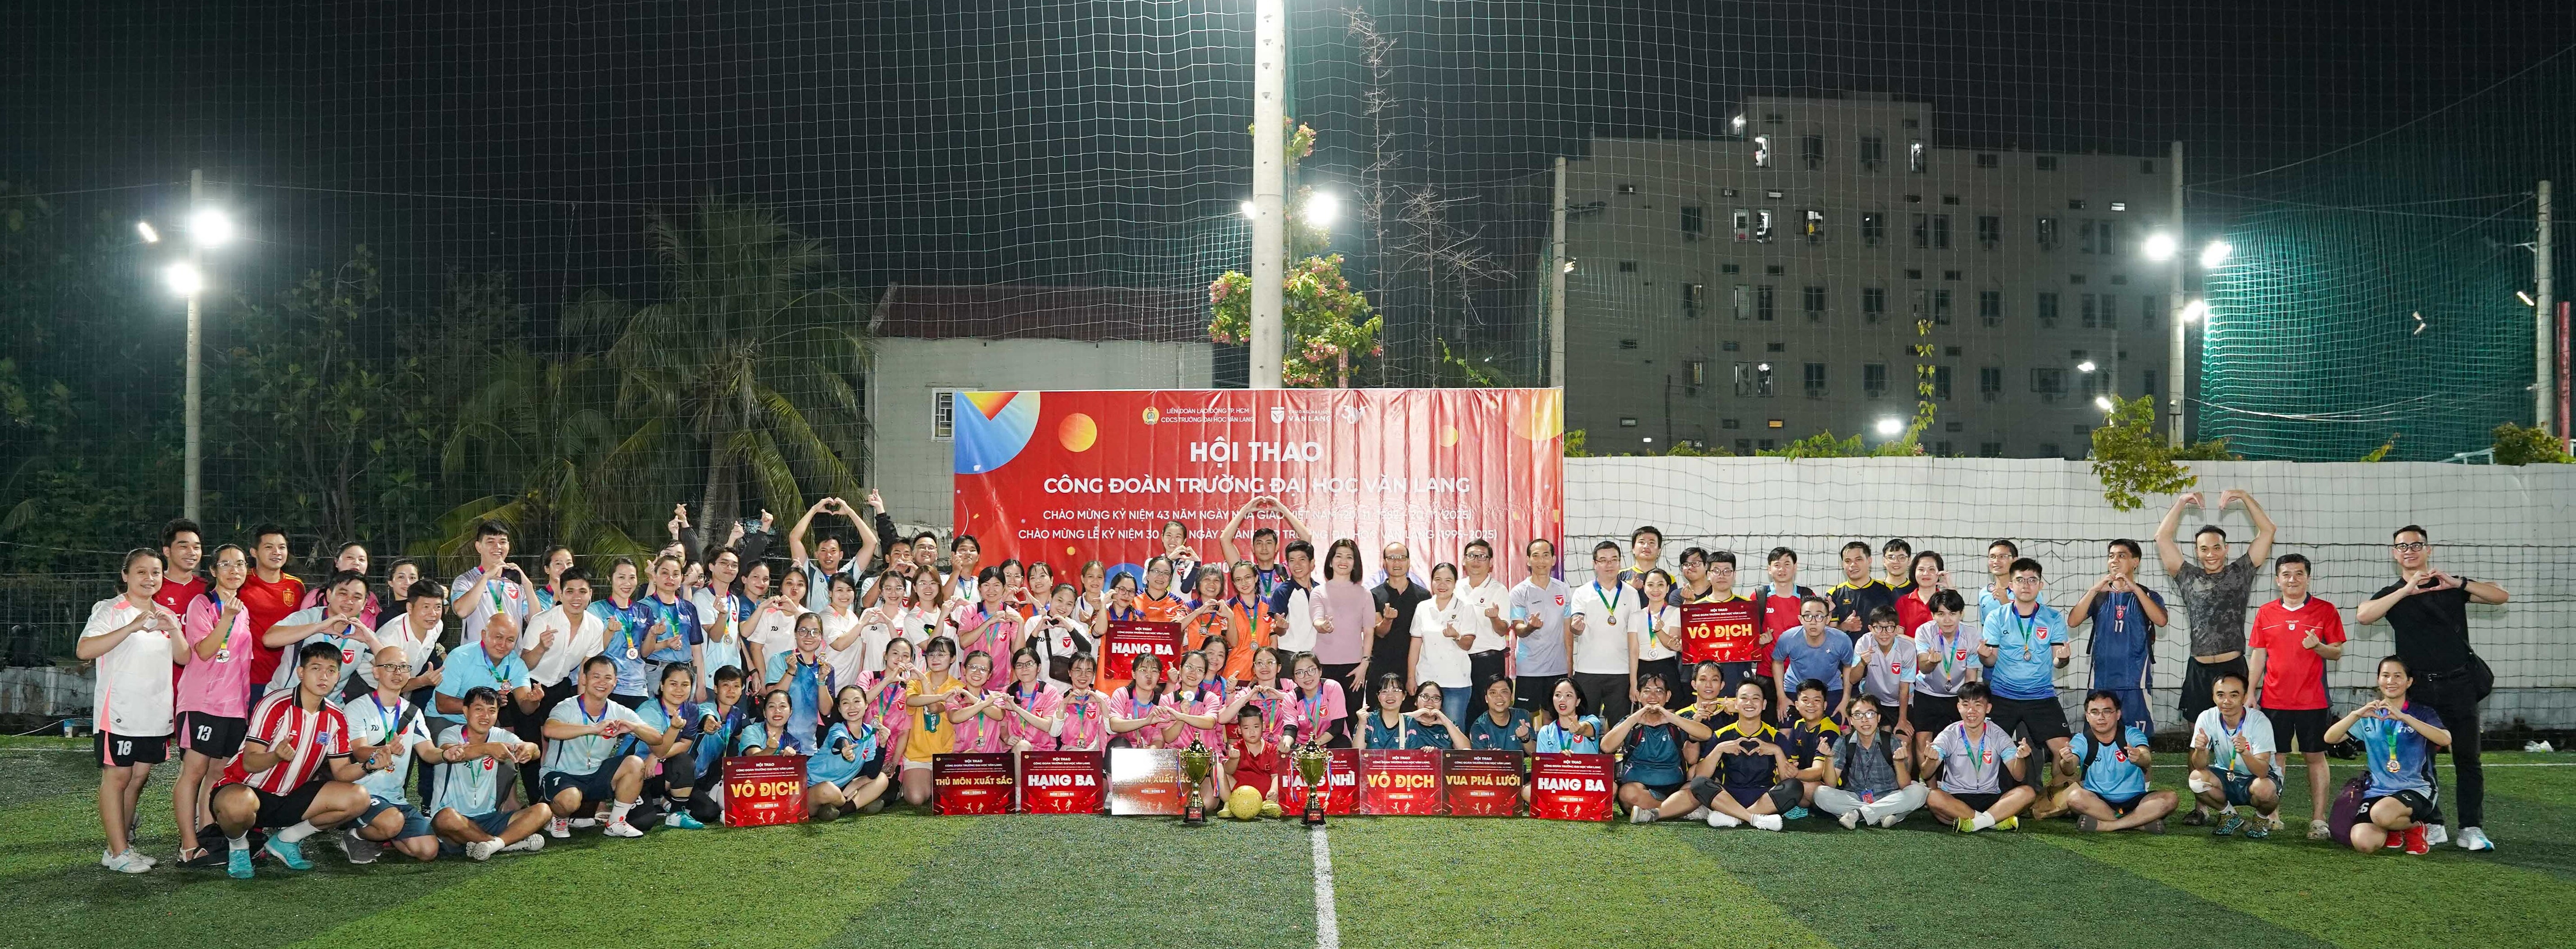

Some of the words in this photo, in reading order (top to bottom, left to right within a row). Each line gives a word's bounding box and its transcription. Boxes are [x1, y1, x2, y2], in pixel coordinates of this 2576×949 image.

[1190, 436, 1238, 468] HỘI
[1248, 441, 1322, 462] THAO
[1044, 474, 1103, 493] CÔNG
[1108, 474, 1170, 493] ĐOÀN
[1176, 474, 1264, 493] TRƯỜNG
[1269, 477, 1305, 497] ĐẠI
[1313, 477, 1358, 497] HỌC
[1363, 474, 1407, 493] VĂN
[1414, 477, 1470, 493] LANG
[1043, 508, 1074, 520] CHÀO
[1077, 508, 1109, 520] MỪNG
[1113, 507, 1126, 520] KỶ
[1129, 508, 1154, 522] NIỆM
[1157, 510, 1169, 520] 43
[1172, 509, 1195, 520] NĂM
[1200, 508, 1229, 520] NGÀY
[1019, 527, 1050, 539] CHÀO
[1052, 527, 1085, 539] MỪNG
[1087, 526, 1099, 539] LỄ
[1102, 527, 1115, 539] KỶ
[1118, 527, 1143, 541] NIỆM
[1146, 529, 1159, 539] 30
[1189, 528, 1218, 539] NGÀY
[1687, 623, 1710, 639] VÔ
[1714, 624, 1752, 640] ĐỊCH
[2114, 620, 2124, 633] 17
[1112, 643, 1152, 657] HẠNG
[1155, 644, 1174, 655] BA
[196, 725, 212, 741] 13
[2135, 720, 2146, 733] 17
[117, 740, 132, 756] 18
[935, 777, 950, 785] THỦ
[952, 777, 971, 785] MÔN
[974, 775, 995, 785] XUẤT
[996, 775, 1013, 785] SẮC
[1028, 775, 1071, 789] HẠNG
[1075, 775, 1095, 786] BA
[1153, 773, 1174, 783] XUẤT
[1331, 770, 1355, 786] NHÌ
[1367, 771, 1390, 788] VÔ
[1395, 774, 1434, 792] ĐỊCH
[1445, 776, 1468, 785] VUA
[1471, 774, 1493, 786] PHÁ
[1496, 774, 1520, 786] LƯỚI
[1538, 777, 1581, 793] HẠNG
[1585, 779, 1606, 792] BA
[730, 779, 755, 797] VÔ
[759, 781, 799, 800] ĐỊCH
